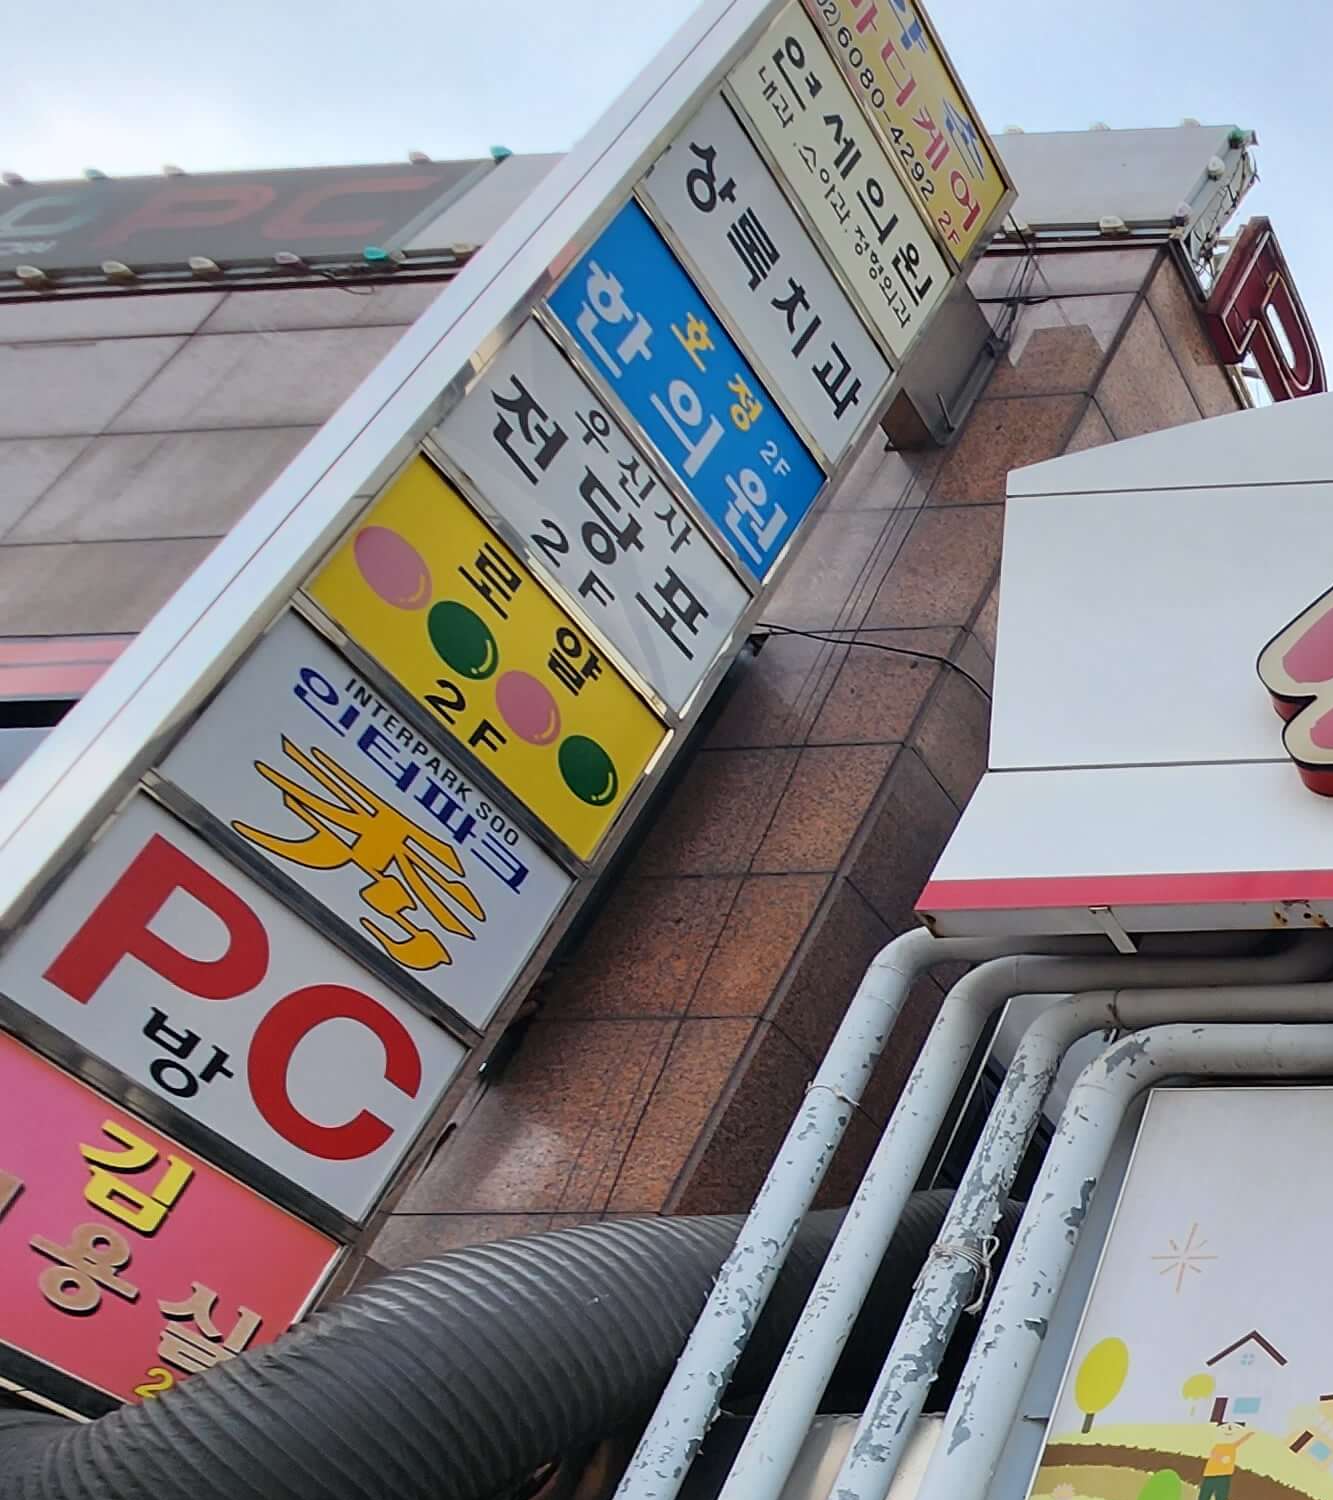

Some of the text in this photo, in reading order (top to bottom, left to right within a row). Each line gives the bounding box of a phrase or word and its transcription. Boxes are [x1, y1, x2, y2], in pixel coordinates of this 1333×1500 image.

[772, 36, 933, 306] 연세의원
[937, 210, 960, 246] 2F
[685, 140, 864, 420] 상록치과
[576, 259, 789, 566] 한의원
[671, 311, 792, 476] 호정 2F
[491, 374, 710, 661] 전당포
[532, 519, 615, 607] 2F
[575, 409, 693, 553] 우신사
[458, 542, 603, 697] 로얄
[293, 667, 529, 895] 인터파크
[344, 677, 520, 846] INTERPARK SOO
[424, 679, 508, 752] 2F
[42, 832, 423, 1162] PC
[142, 1006, 235, 1099] 방
[0, 1168, 263, 1375] 용실
